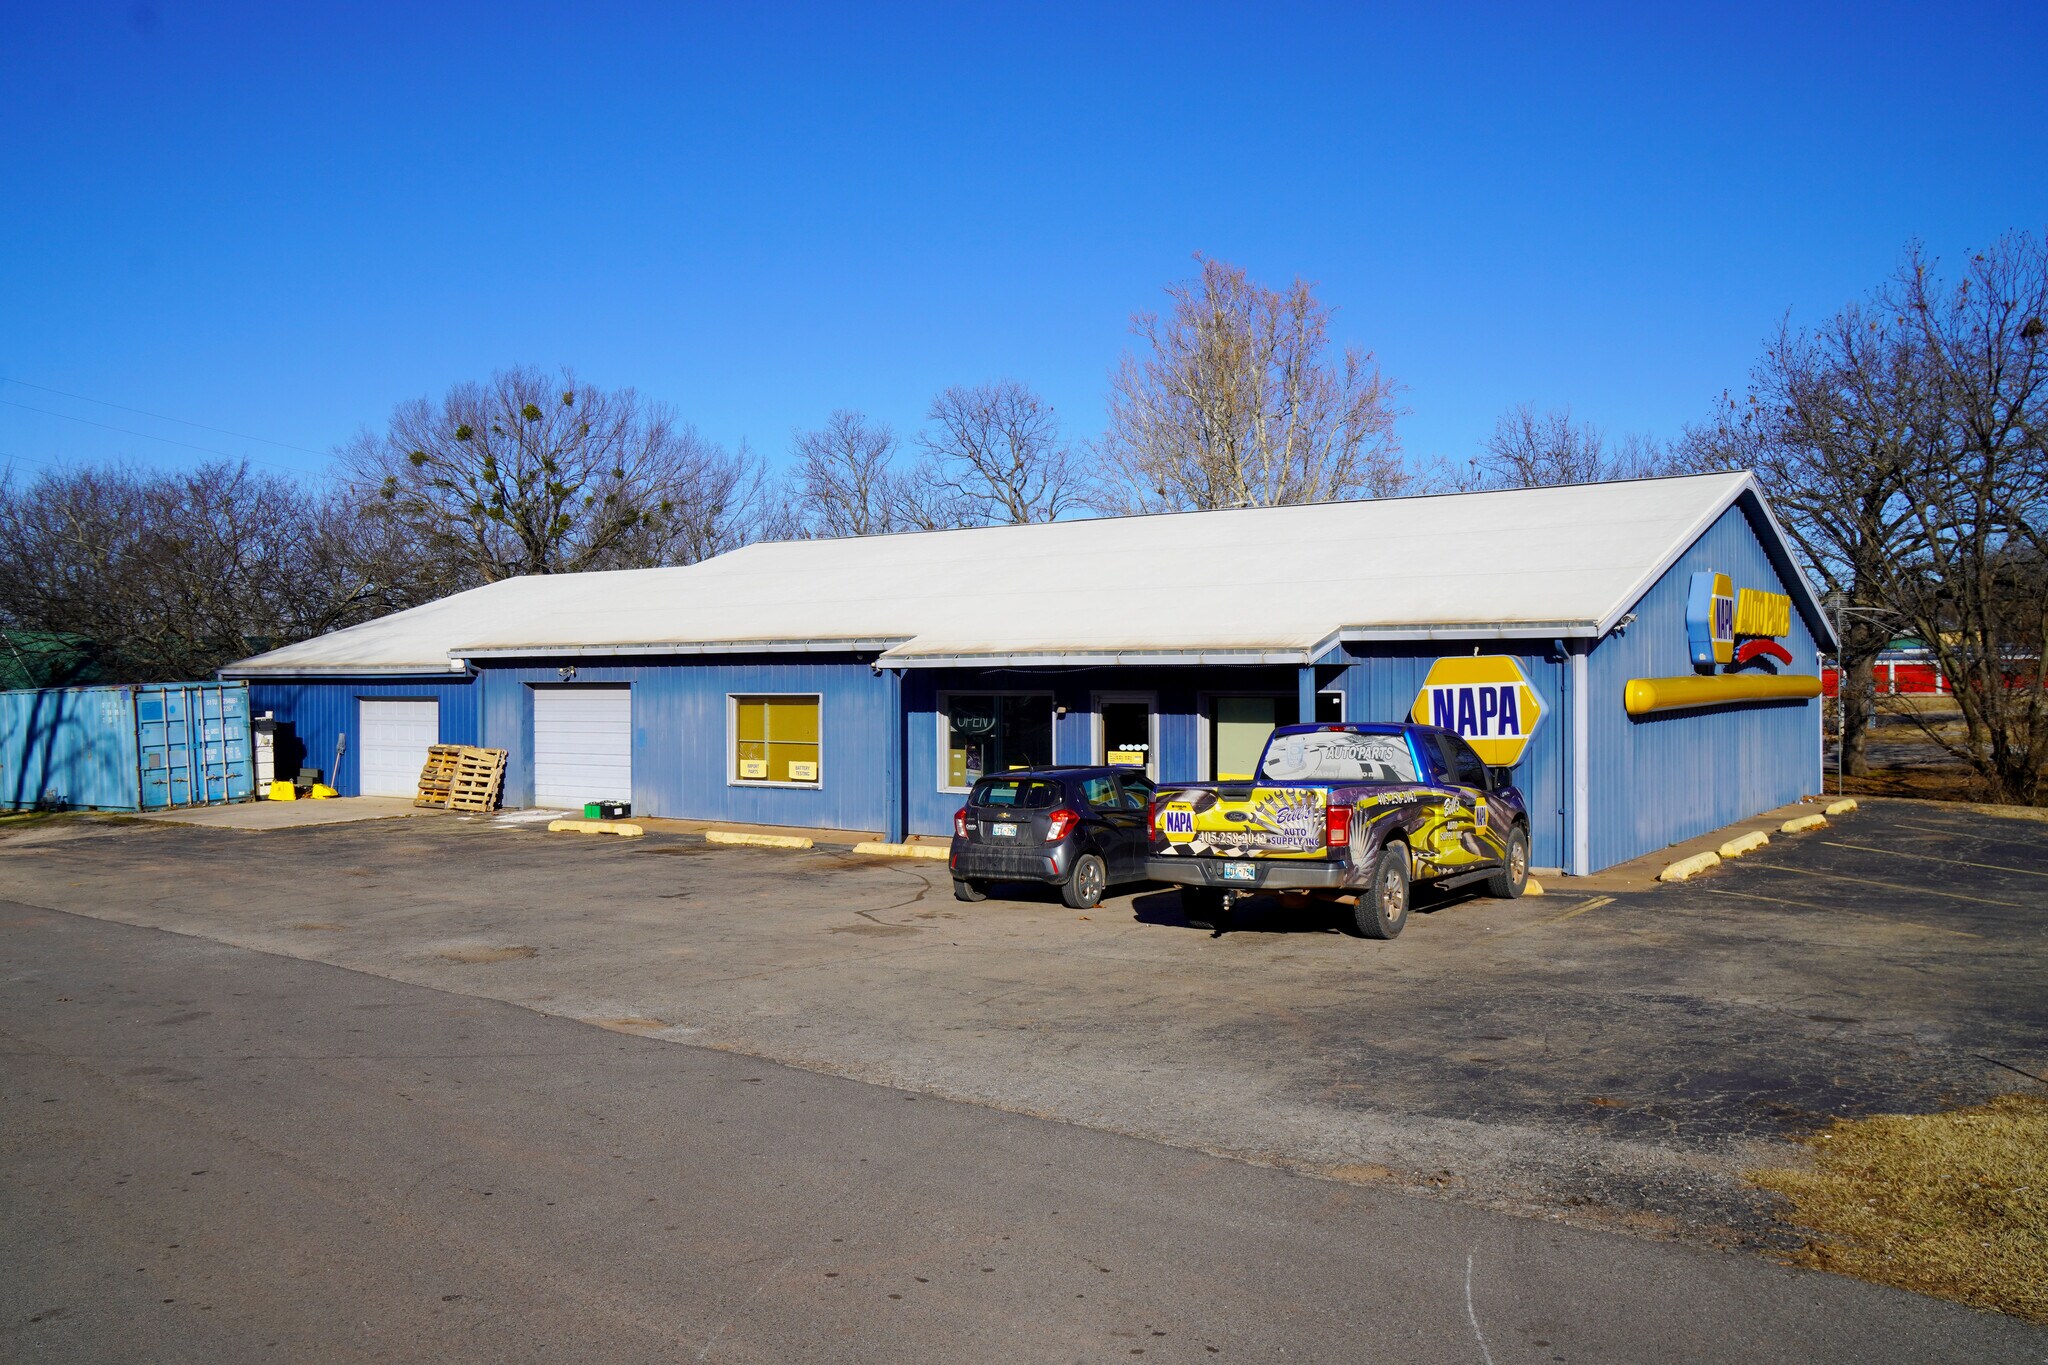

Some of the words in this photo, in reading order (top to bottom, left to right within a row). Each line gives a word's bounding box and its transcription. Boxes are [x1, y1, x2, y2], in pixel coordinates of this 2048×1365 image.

[1716, 598, 1733, 640] NAPA
[1735, 588, 1763, 635] AUTO
[1762, 591, 1791, 637] PARTS
[1433, 686, 1520, 736] NAPA
[957, 715, 988, 728] OPEN
[1326, 746, 1358, 760] AUTO
[1357, 746, 1394, 760] PARTS
[1166, 811, 1193, 833] NAPA
[1277, 804, 1310, 824] Bill's
[1199, 831, 1267, 845] 405-258-2042
[1284, 828, 1307, 836] AUTO
[1271, 836, 1302, 845] SUPPLY
[1305, 838, 1319, 846] INC
